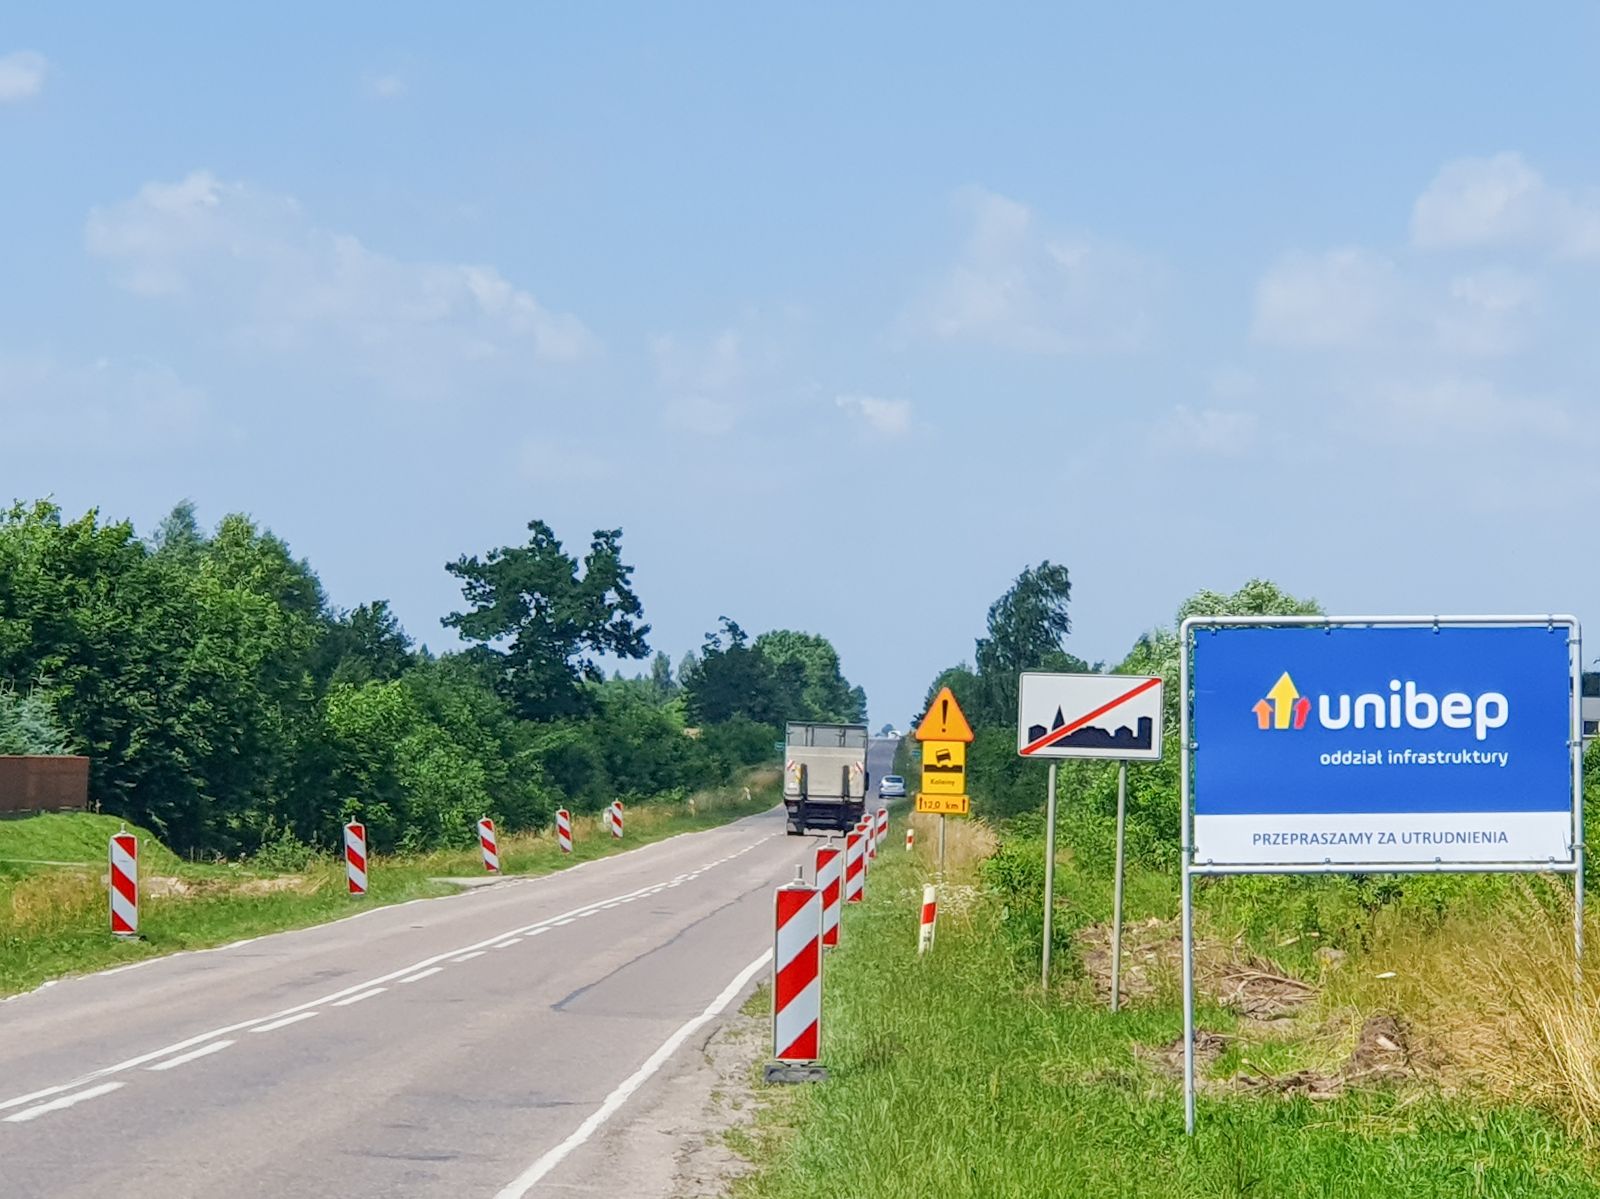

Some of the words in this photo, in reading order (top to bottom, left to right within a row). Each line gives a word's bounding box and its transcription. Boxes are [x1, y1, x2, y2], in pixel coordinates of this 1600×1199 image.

[1319, 679, 1508, 741] unibep
[1320, 750, 1383, 766] oddział
[1388, 749, 1508, 767] infrastruktury
[945, 800, 959, 809] km
[1253, 832, 1373, 846] PRZEPRASZAMY
[1377, 832, 1397, 845] ZA
[1402, 831, 1508, 845] UTRUDNIENIA
